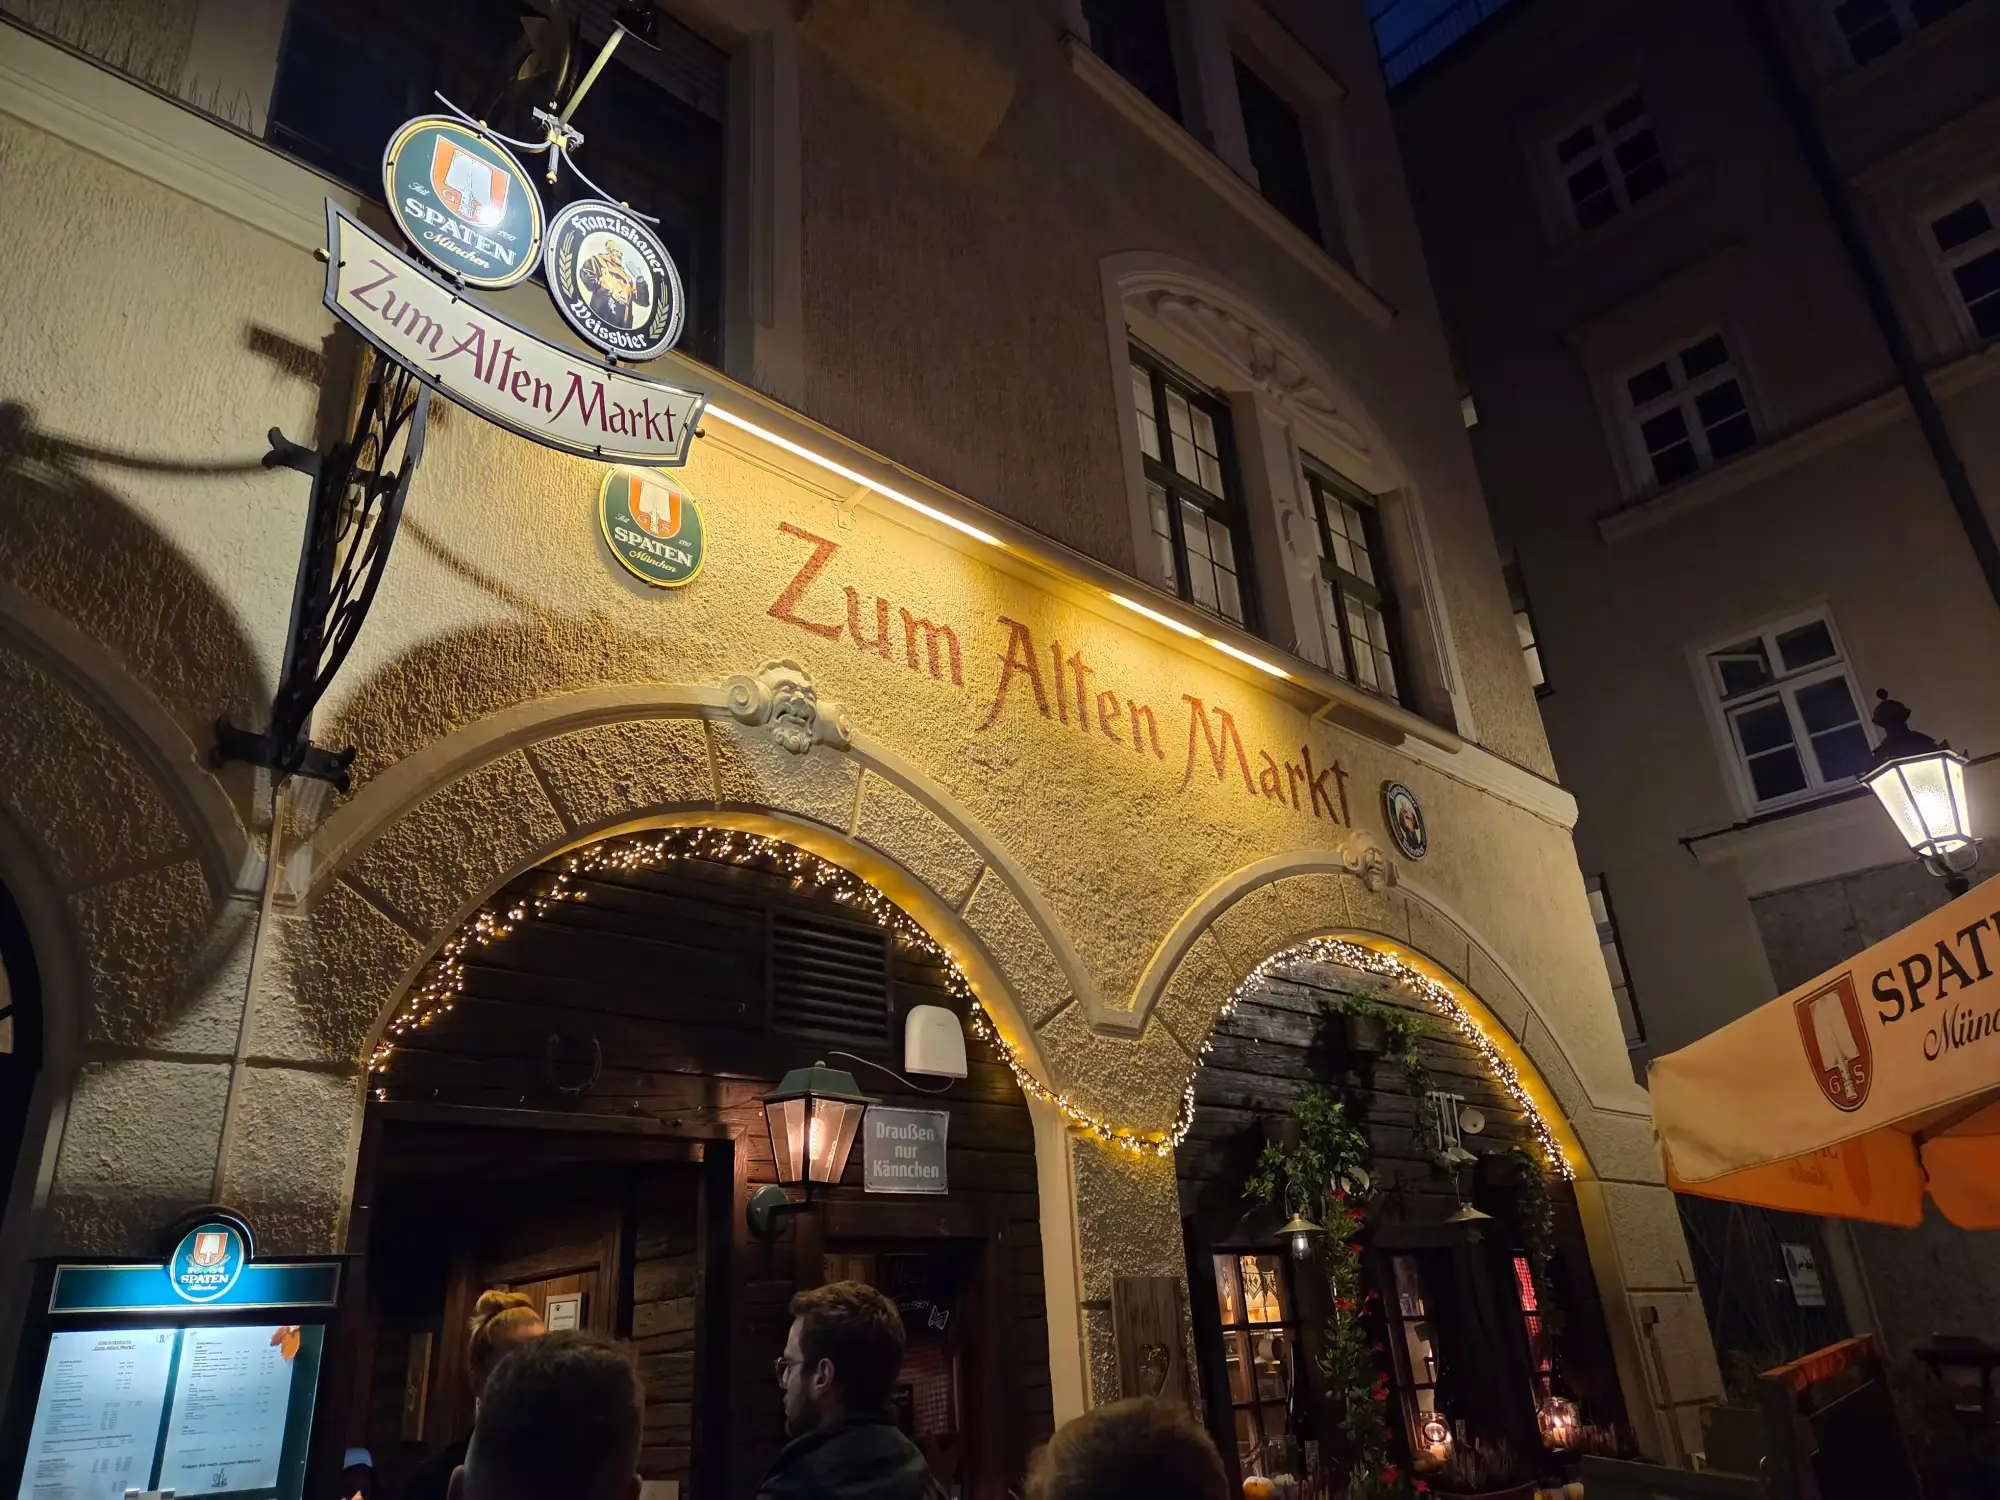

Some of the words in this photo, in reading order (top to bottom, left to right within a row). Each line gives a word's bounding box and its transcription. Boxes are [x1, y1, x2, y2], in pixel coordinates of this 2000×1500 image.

[405, 197, 517, 267] SPATEN
[423, 230, 491, 270] München
[571, 214, 665, 278] Franziskaner
[570, 298, 648, 349] Weissbier
[349, 258, 447, 355] Zum
[427, 320, 554, 413] Alten
[544, 370, 677, 443] Markt
[614, 526, 694, 568] SPATEN
[629, 550, 677, 573] München
[766, 520, 964, 687] Zum
[975, 615, 1165, 760] Alten
[1176, 692, 1351, 829] Markt
[876, 1121, 935, 1142] Draußen
[894, 1145, 918, 1159] nur
[873, 1159, 940, 1179] Kännchen
[180, 1274, 230, 1285] SPATEN
